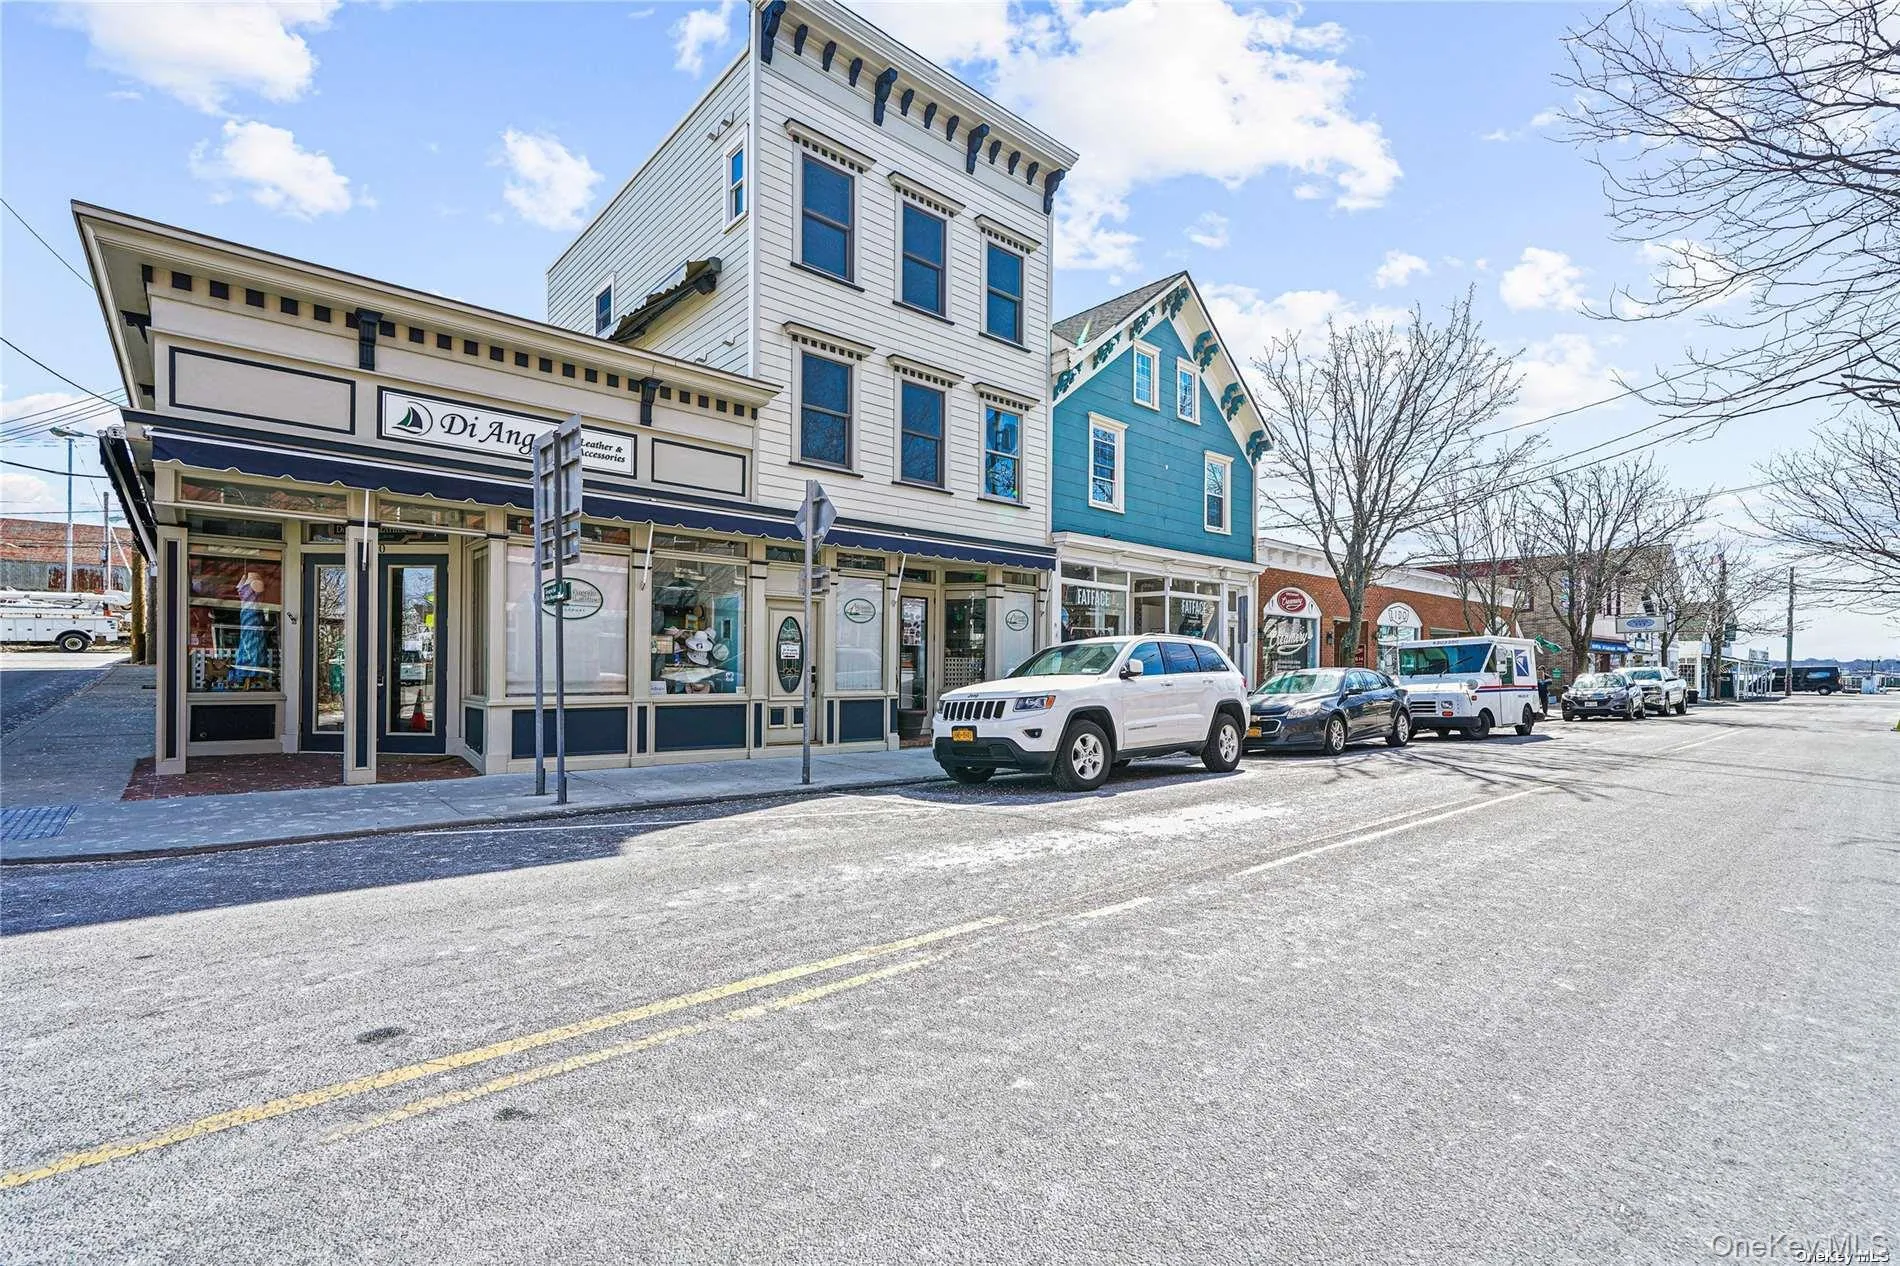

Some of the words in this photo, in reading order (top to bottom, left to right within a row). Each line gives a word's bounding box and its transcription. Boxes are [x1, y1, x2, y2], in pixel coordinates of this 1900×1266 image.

[440, 413, 478, 438] Di
[478, 421, 536, 455] Ang
[581, 438, 613, 451] Leather
[1077, 588, 1110, 606] FATFACE
[1181, 600, 1207, 615] FATFACE
[1270, 632, 1309, 656] Creamery
